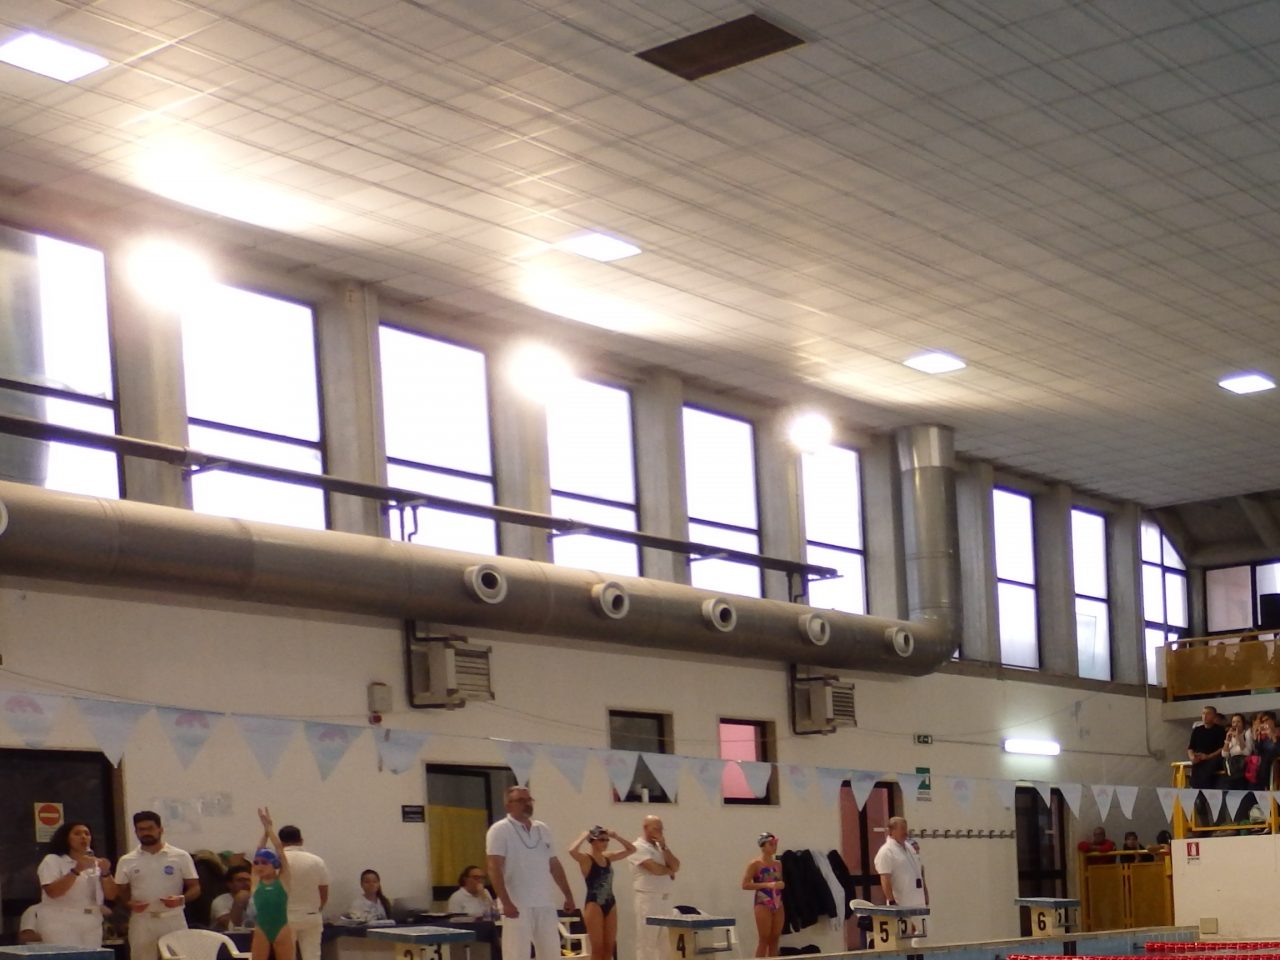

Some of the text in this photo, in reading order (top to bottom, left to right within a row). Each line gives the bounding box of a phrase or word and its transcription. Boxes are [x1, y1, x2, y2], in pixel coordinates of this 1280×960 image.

[879, 921, 889, 943] 5
[1037, 911, 1047, 931] 6
[676, 933, 686, 958] 4
